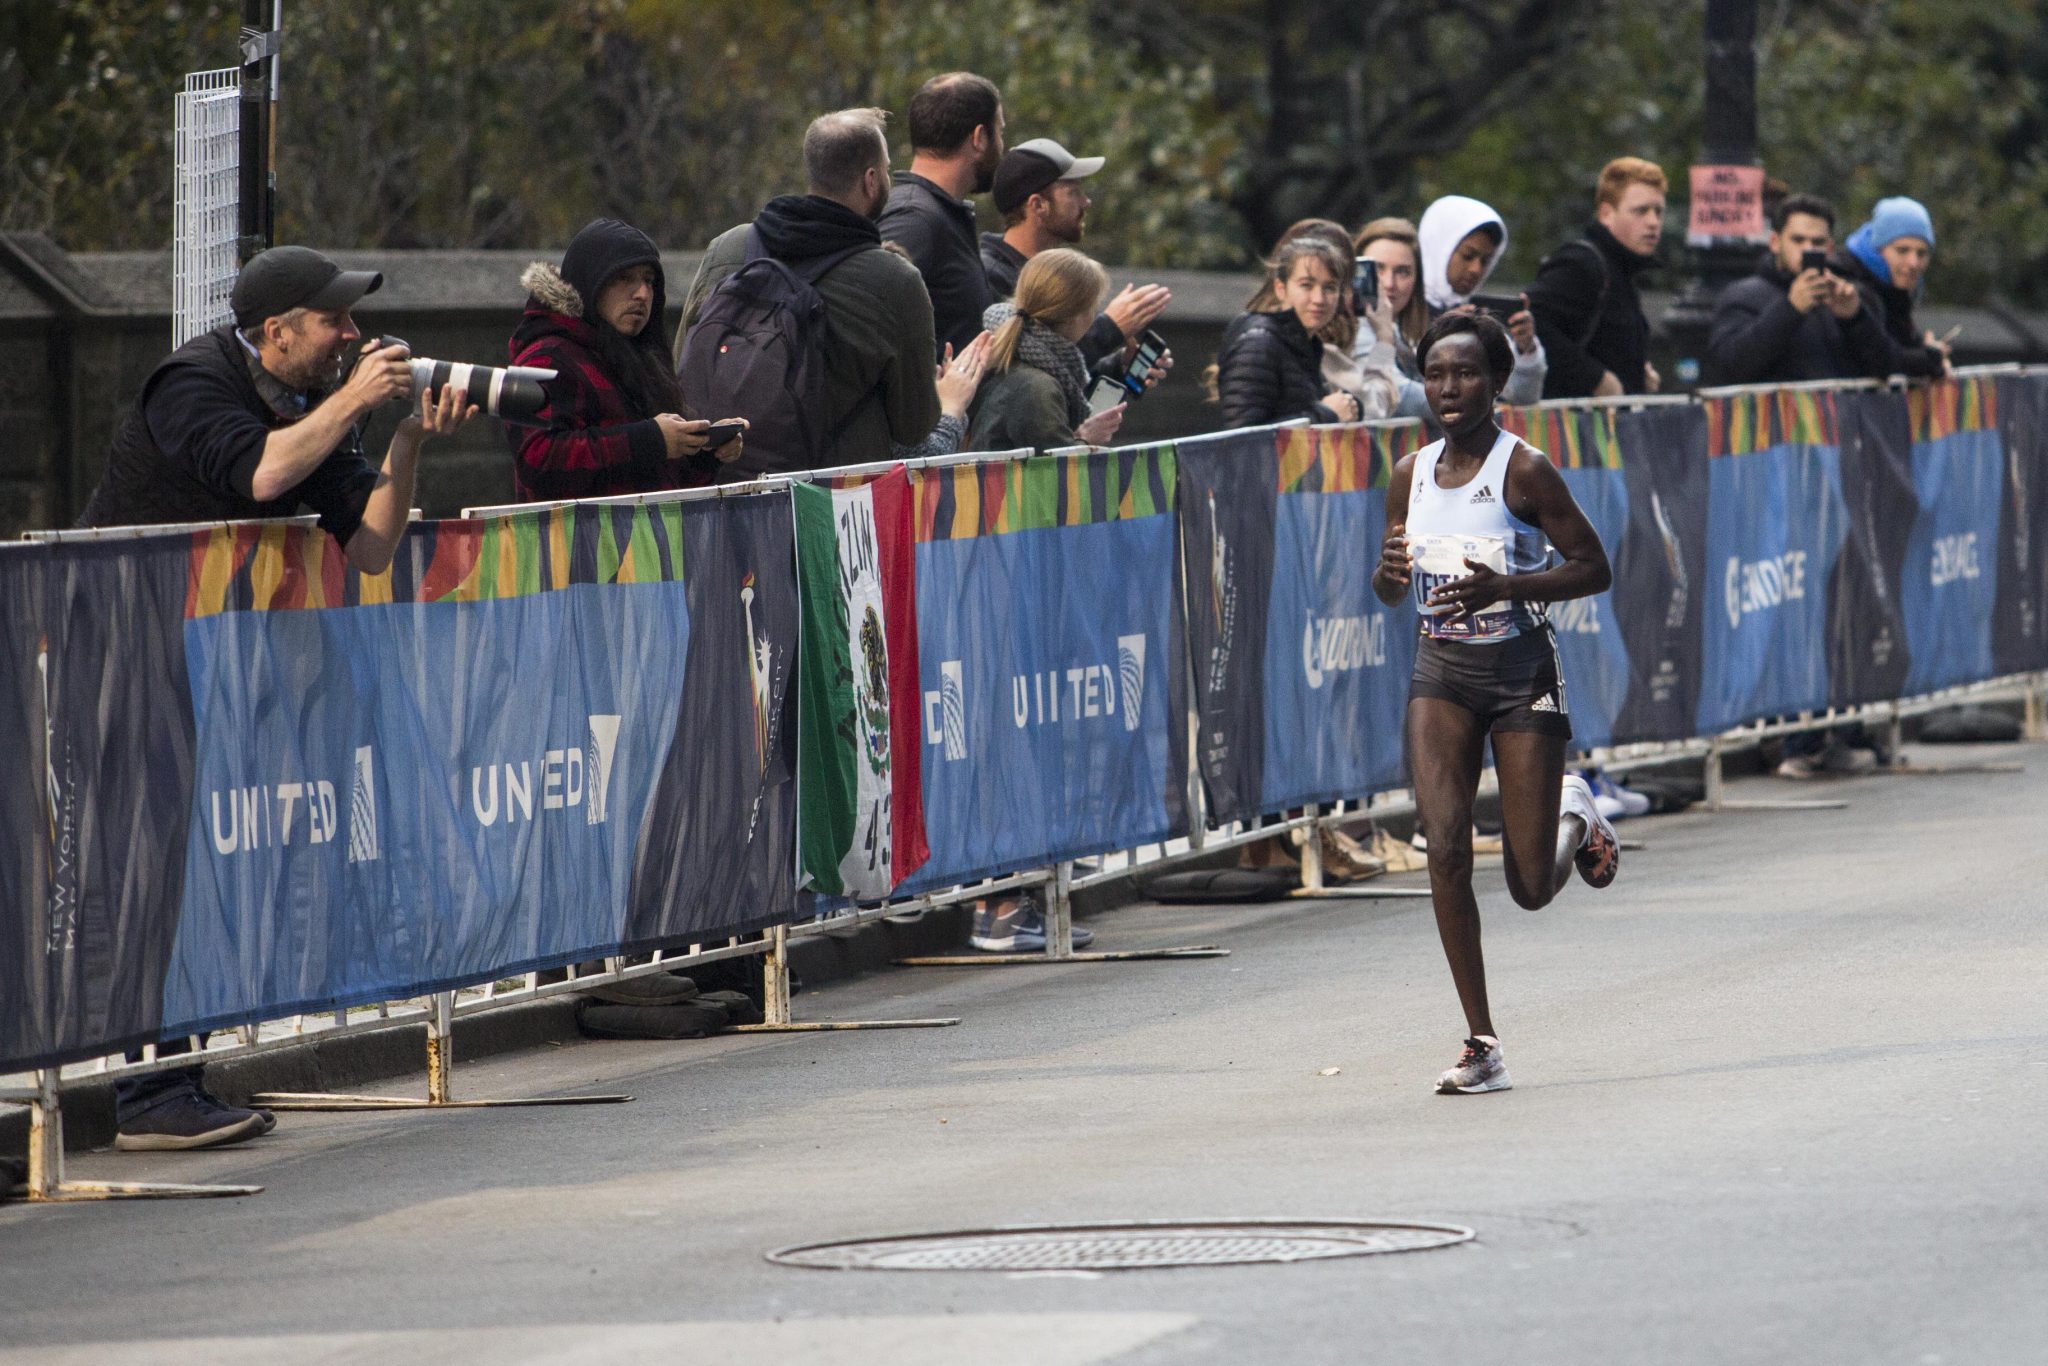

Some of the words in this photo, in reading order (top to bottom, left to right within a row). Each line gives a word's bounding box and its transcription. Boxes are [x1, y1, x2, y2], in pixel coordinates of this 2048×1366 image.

[1532, 703, 1558, 712] adidas
[211, 780, 337, 855] UNITED
[51, 884, 66, 950] NEW
